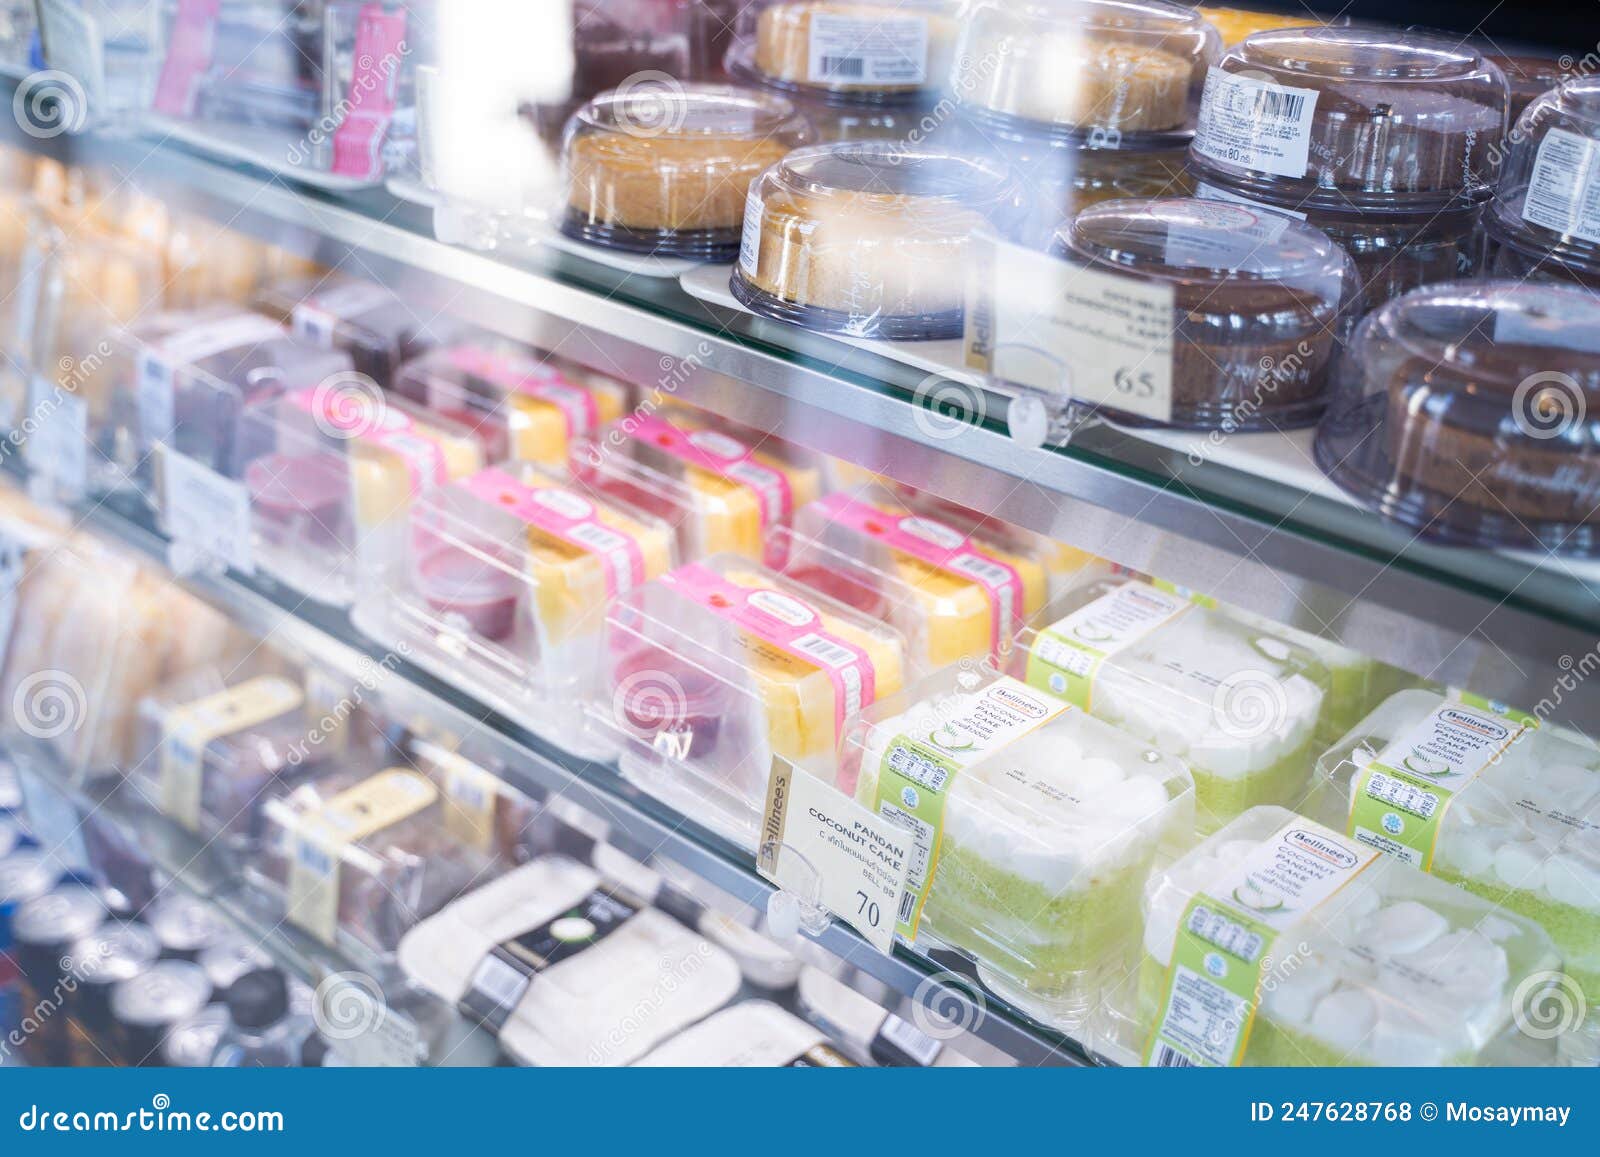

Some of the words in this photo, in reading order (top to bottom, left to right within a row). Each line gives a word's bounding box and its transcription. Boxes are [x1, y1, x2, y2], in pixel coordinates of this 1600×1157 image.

[1228, 149, 1239, 160] 80
[1114, 367, 1155, 397] 65
[980, 700, 1026, 723] COCONUT
[996, 689, 1043, 715] Bellinee's
[974, 713, 1001, 728] CAKE
[976, 705, 1013, 727] PANDAN
[1447, 711, 1503, 736] Bellinee's
[1434, 729, 1481, 750] PANDAN
[1435, 722, 1491, 746] COCONUT
[1436, 737, 1468, 752] CAKE
[761, 776, 786, 861] Bellinee's
[808, 807, 865, 846] COCONUT
[869, 844, 901, 871] CAKE
[854, 821, 904, 858] PANDAN
[1294, 832, 1353, 863] Bellinee's
[1275, 854, 1323, 879] PANDAN
[1275, 863, 1309, 881] CAKE
[1278, 846, 1336, 875] COCONUT
[863, 868, 881, 889] BELL
[856, 890, 880, 927] 70
